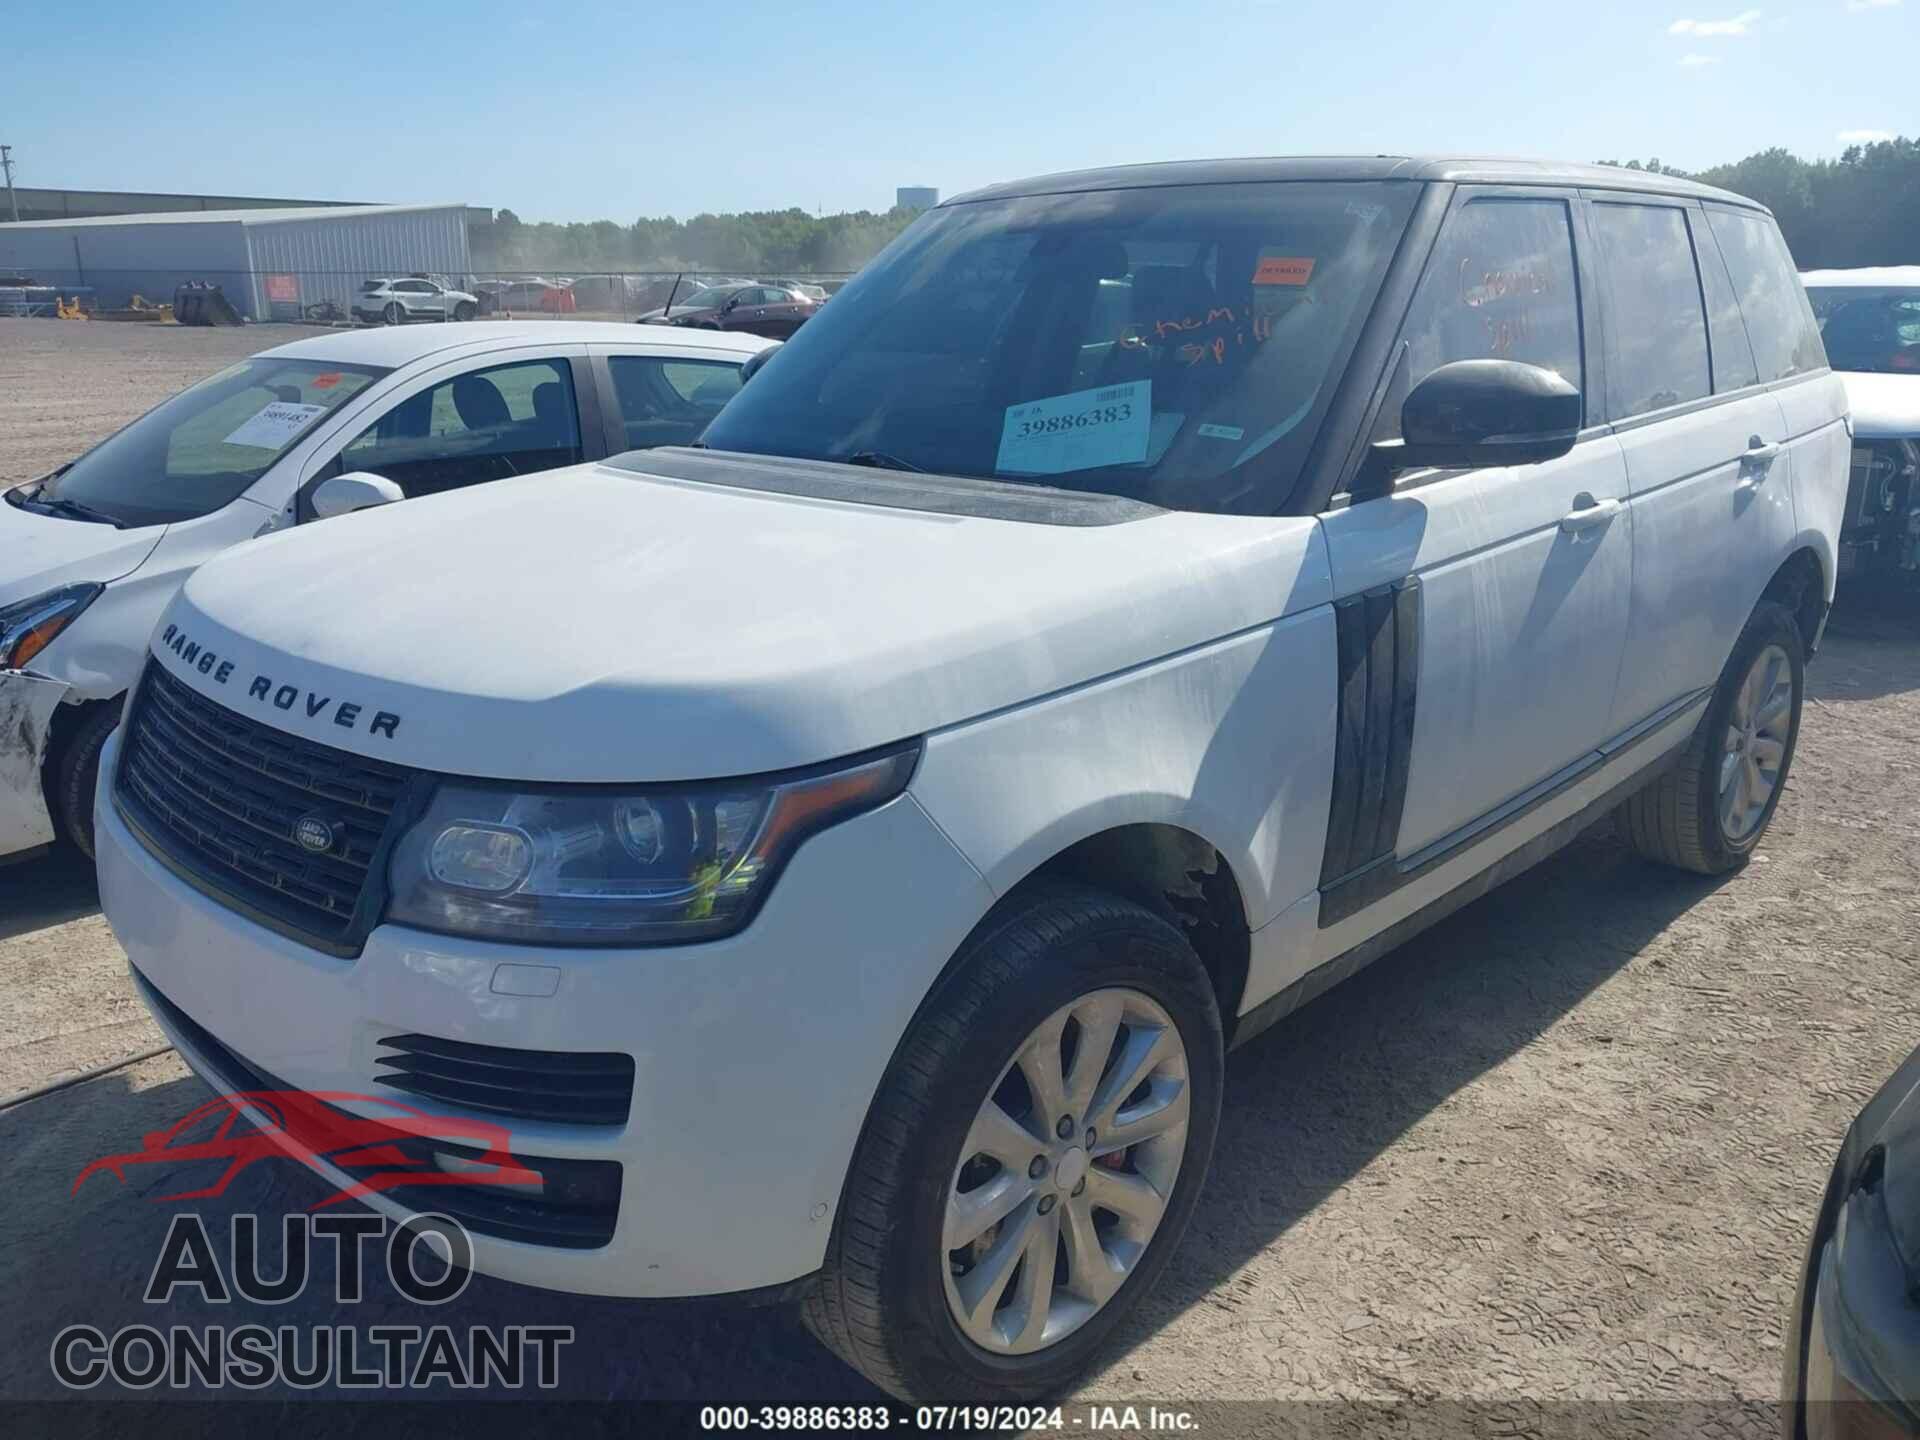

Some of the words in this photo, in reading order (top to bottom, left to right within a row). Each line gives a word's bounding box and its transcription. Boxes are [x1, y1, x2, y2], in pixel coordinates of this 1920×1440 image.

[1016, 403, 1131, 439] 39886383
[162, 624, 235, 684] RANGE
[248, 675, 401, 739] ROVER
